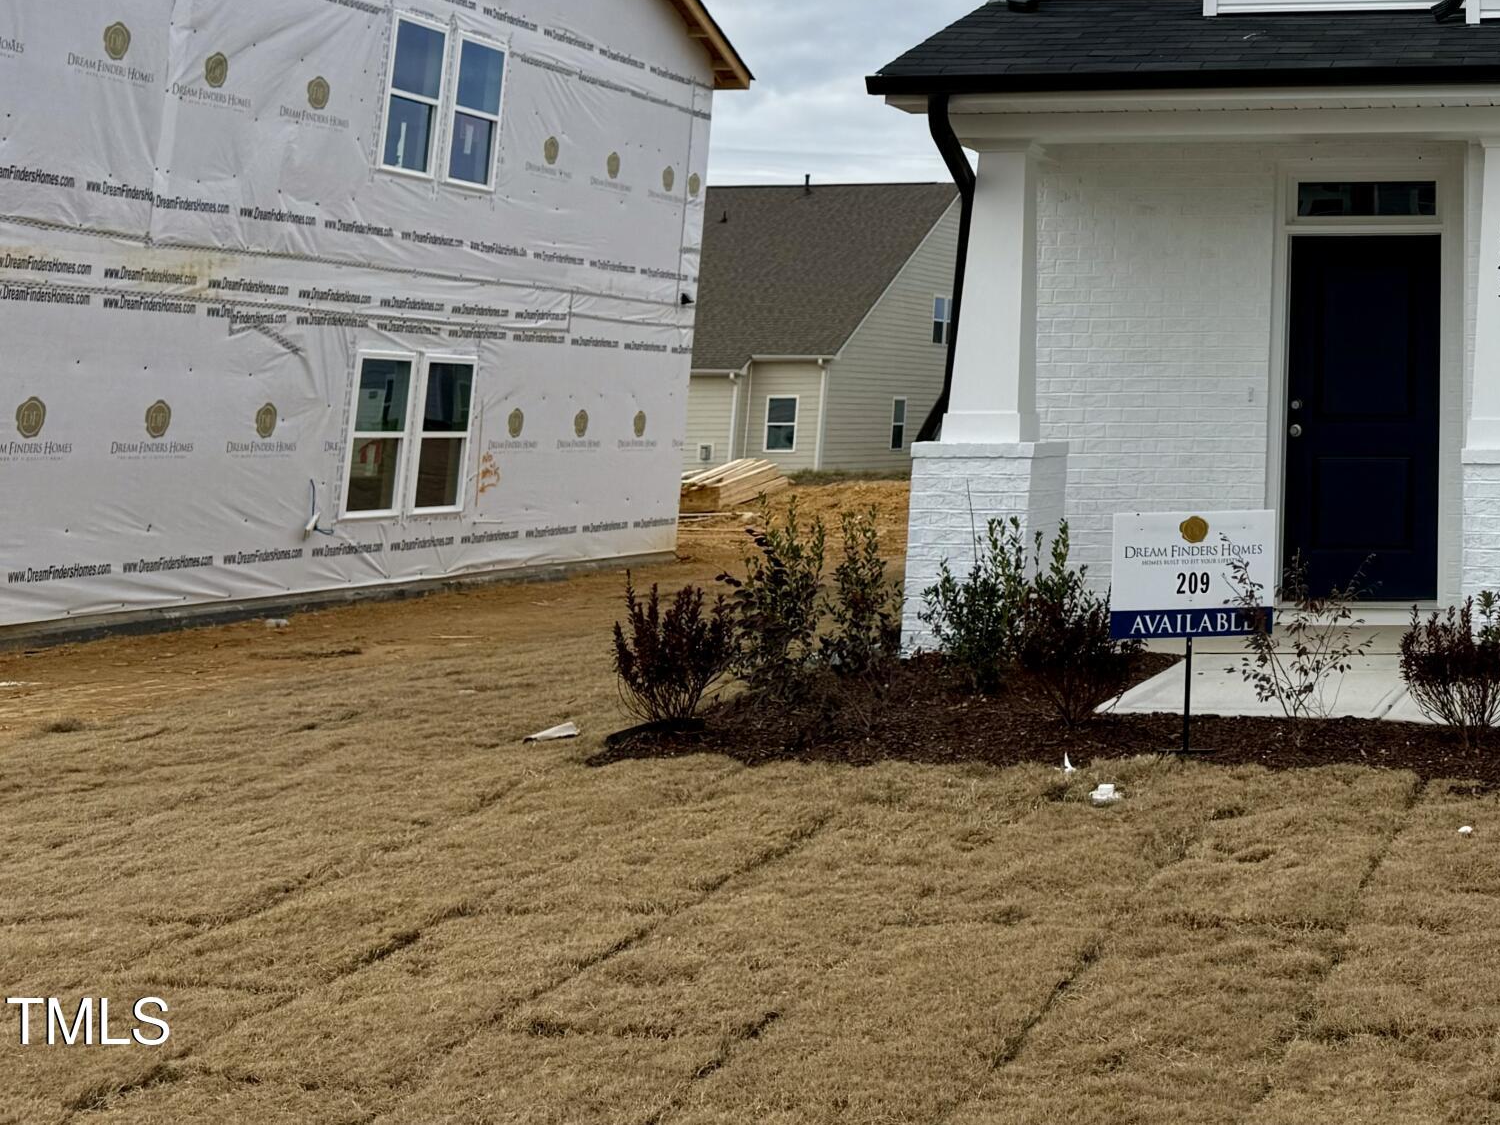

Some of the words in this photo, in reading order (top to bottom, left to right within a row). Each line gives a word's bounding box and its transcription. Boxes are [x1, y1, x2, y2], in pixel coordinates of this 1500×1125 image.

[67, 52, 96, 70] DREAM
[172, 82, 198, 97] DREAM
[104, 266, 197, 285] www.DreamFindersHomes.com
[208, 277, 289, 296] www.DreamFindersHomes.com
[103, 294, 196, 314] www.DreamFindersHomes.com
[9, 441, 42, 455] FINDERS
[43, 441, 72, 454] HOMES
[110, 441, 139, 455] DREAM
[139, 441, 168, 454] FINDERS
[169, 441, 194, 453] HOMES
[223, 548, 303, 565] www.DreamFindersHomes.com
[1124, 546, 1168, 559] DREAM
[1171, 545, 1218, 557] FINDERS
[1221, 544, 1263, 557] HOMES
[8, 563, 111, 584] www.DreamFindersHomes.com
[122, 555, 213, 574] www.DreamFindersHomes.com
[1176, 572, 1210, 595] 209
